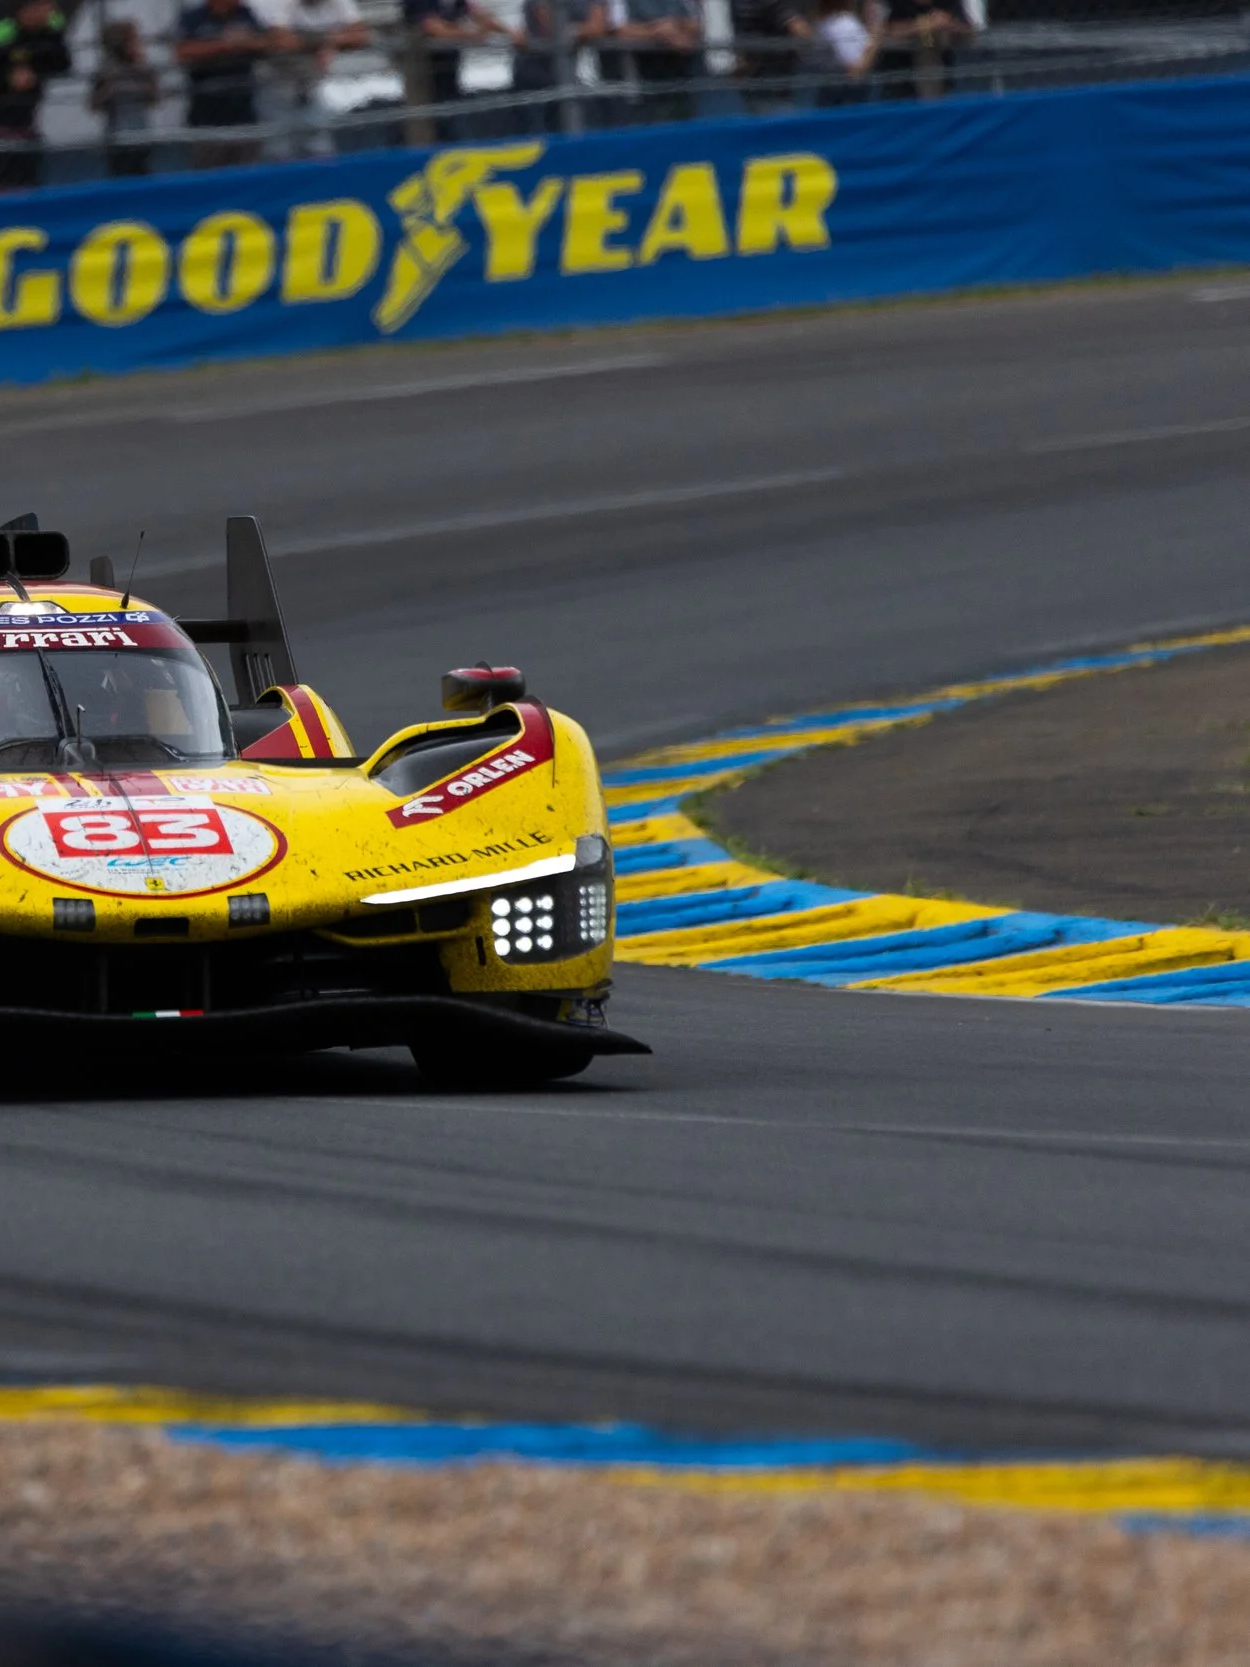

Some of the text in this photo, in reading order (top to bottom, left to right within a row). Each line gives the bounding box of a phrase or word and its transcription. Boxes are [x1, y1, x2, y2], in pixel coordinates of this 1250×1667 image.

[38, 613, 118, 624] POZZI
[446, 750, 536, 796] ORLEN
[59, 813, 220, 850] 83
[343, 830, 553, 882] RICHARD MILLE
